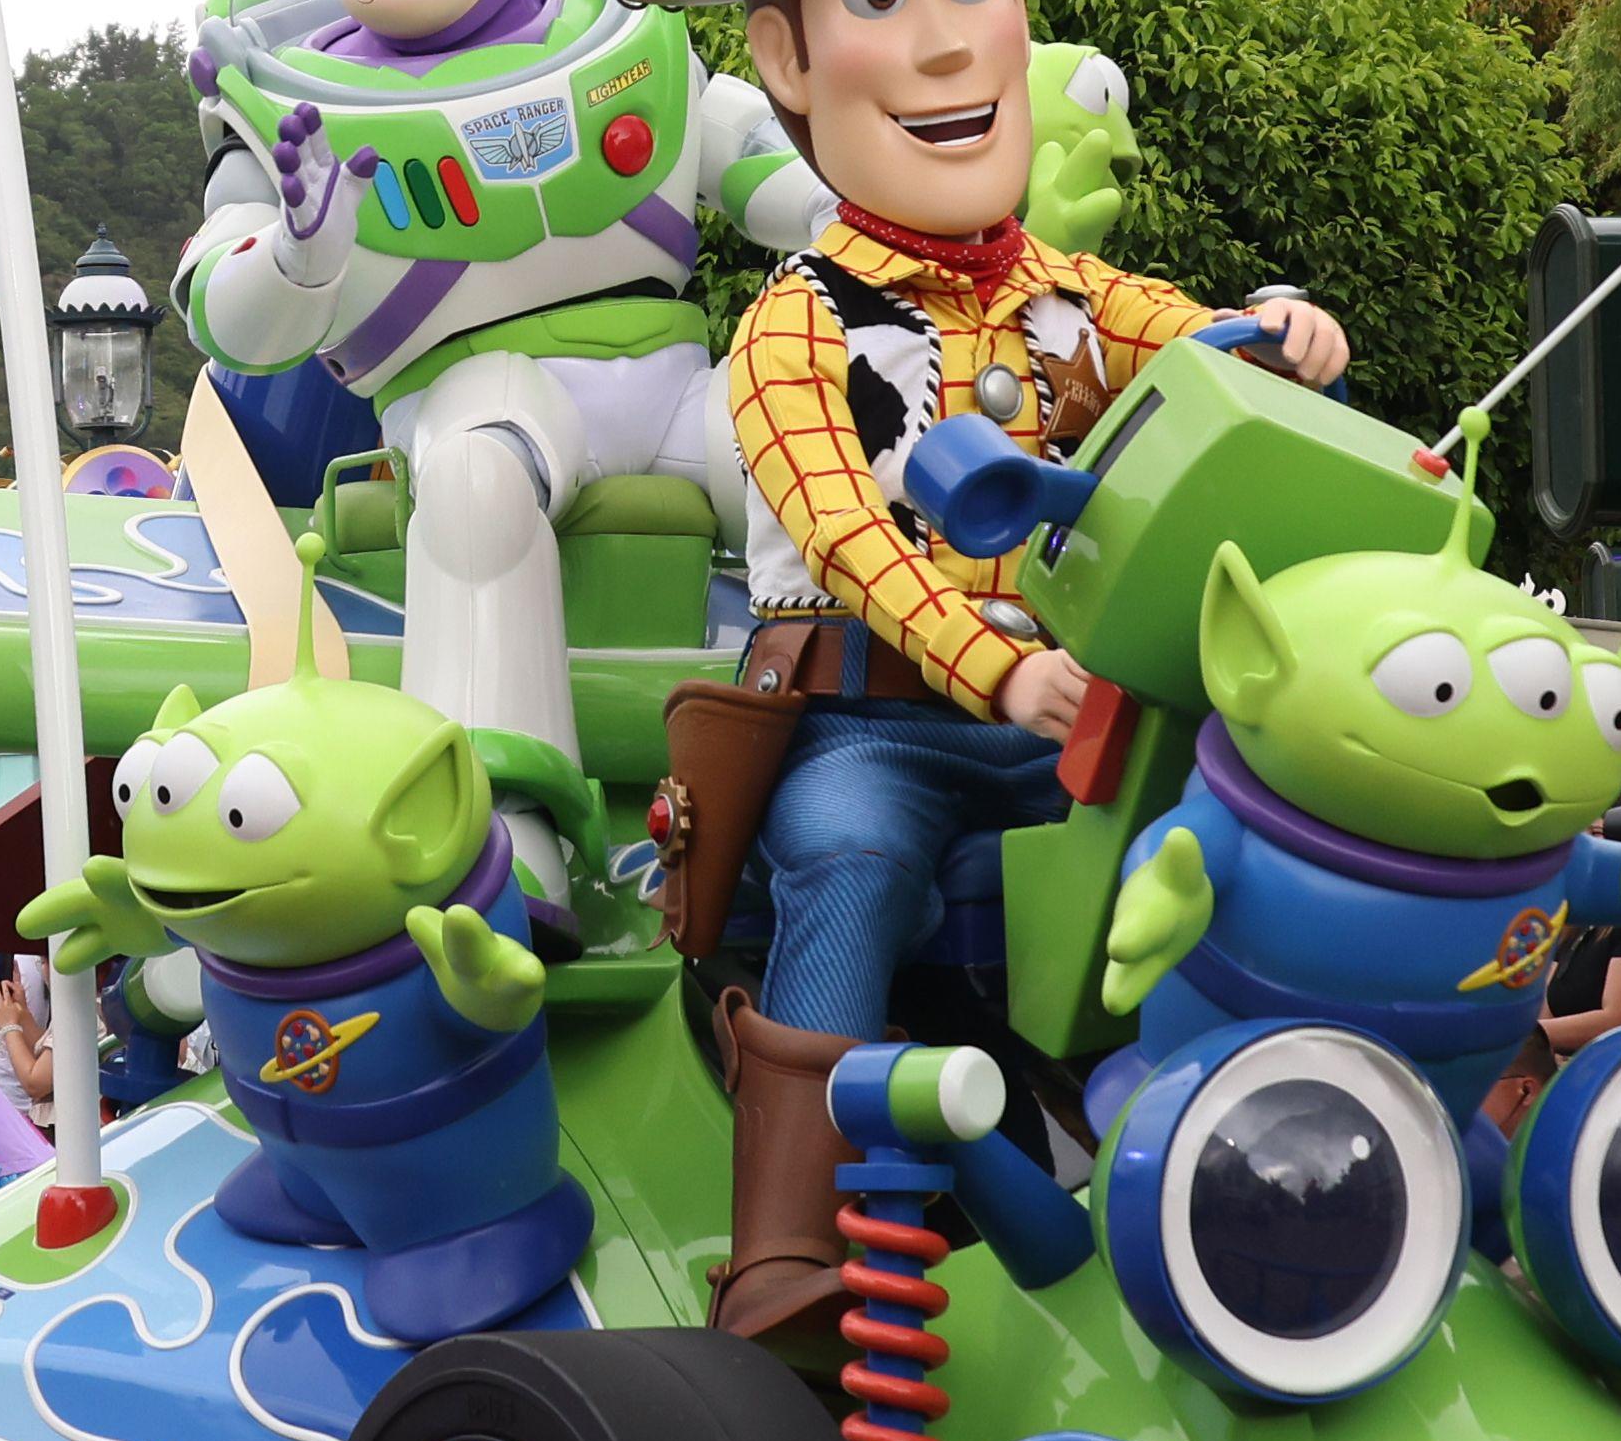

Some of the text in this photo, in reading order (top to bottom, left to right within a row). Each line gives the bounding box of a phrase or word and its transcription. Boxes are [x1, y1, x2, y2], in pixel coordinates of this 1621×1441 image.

[588, 59, 651, 106] LIGHTYEAR
[464, 99, 565, 136] SPACE RANGER
